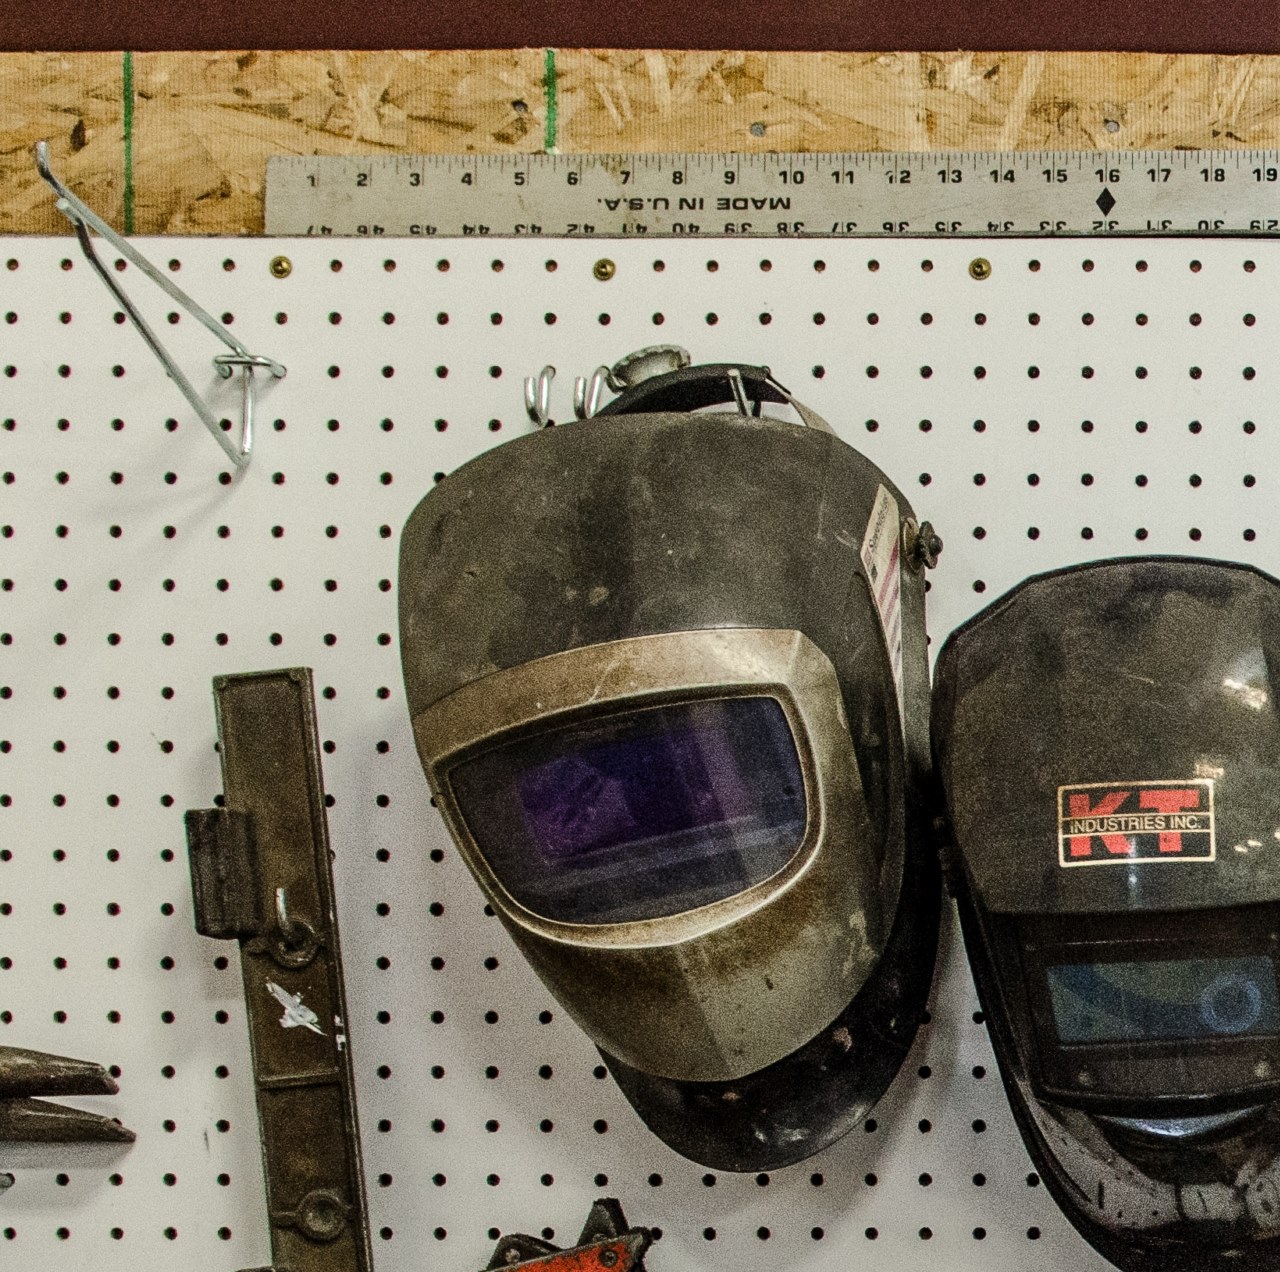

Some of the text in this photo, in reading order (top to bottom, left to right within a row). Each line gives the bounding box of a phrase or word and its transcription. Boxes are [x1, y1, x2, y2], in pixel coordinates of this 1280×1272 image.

[305, 171, 316, 188] 1
[356, 171, 368, 188] 2
[409, 170, 421, 187] 3
[460, 170, 473, 187] 4
[514, 170, 526, 187] 5
[566, 170, 579, 187] 6
[620, 170, 631, 187] 7
[672, 169, 684, 186] 8
[724, 169, 736, 186] 9
[778, 169, 805, 186] 10
[831, 169, 855, 186] 11
[937, 168, 963, 185] 13
[989, 168, 1016, 185] 14
[1042, 168, 1068, 185] 15
[1094, 167, 1120, 184] 16
[1147, 167, 1172, 184] 17
[1200, 167, 1226, 184] 18
[1252, 167, 1278, 184] 19
[597, 197, 792, 211] MADE IN U.S.A.
[1069, 788, 1200, 857] KT
[1069, 814, 1202, 835] INDUSTRIES INC.
